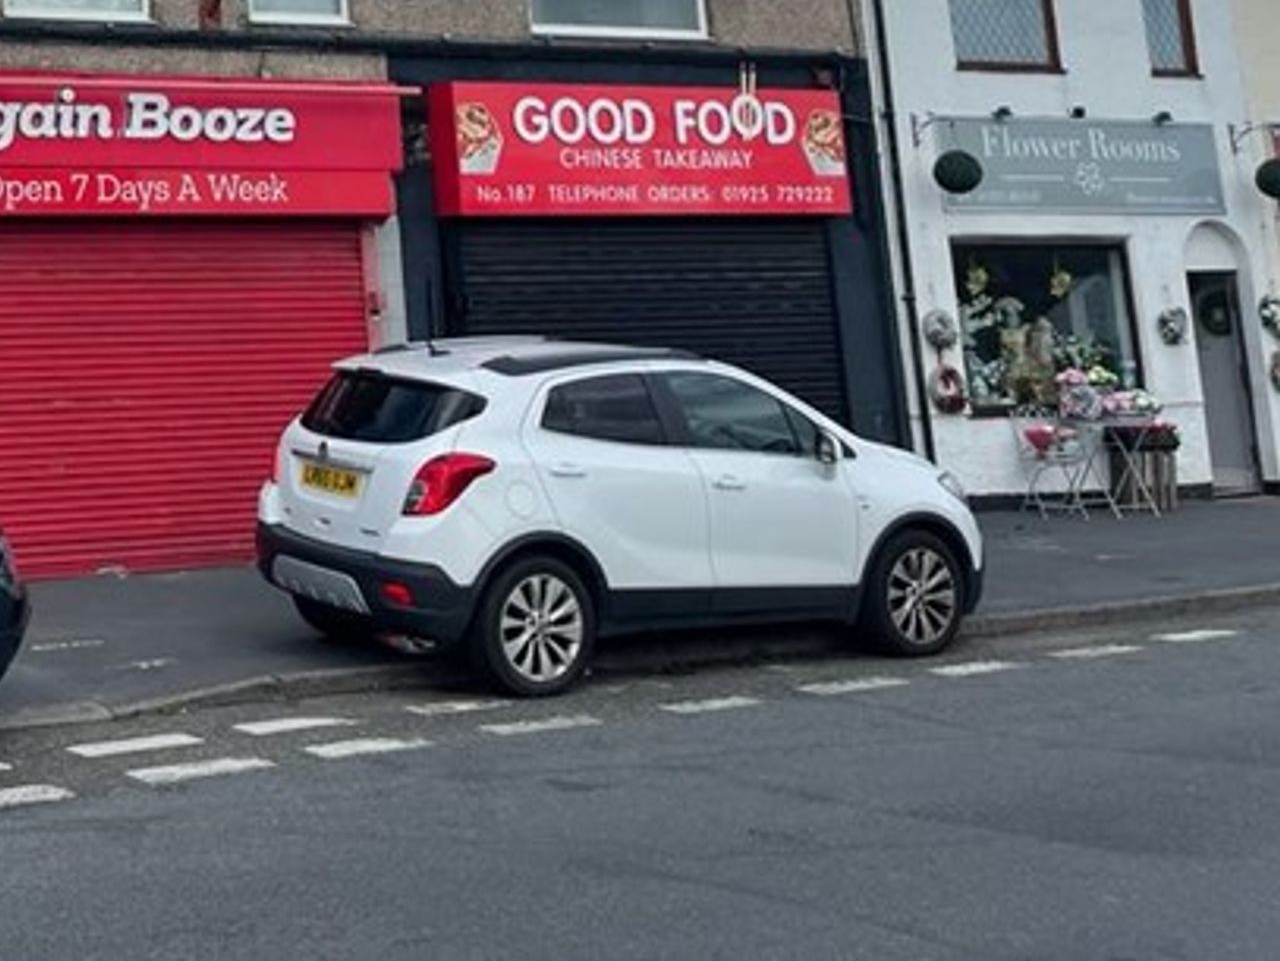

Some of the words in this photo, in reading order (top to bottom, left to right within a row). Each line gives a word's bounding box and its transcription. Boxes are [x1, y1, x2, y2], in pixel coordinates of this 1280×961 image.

[124, 91, 296, 142] Booze
[512, 95, 656, 145] GOOD
[673, 92, 797, 146] FOOD
[559, 147, 644, 170] CHINESE
[652, 149, 755, 170] TAKEAWAY
[980, 124, 1083, 160] Flower
[1086, 127, 1182, 163] Rooms
[70, 173, 90, 202] 7
[96, 173, 170, 211] Days
[176, 173, 203, 202] A
[207, 171, 289, 203] Week
[547, 184, 640, 203] TELEPHONE
[721, 184, 770, 203] 01925
